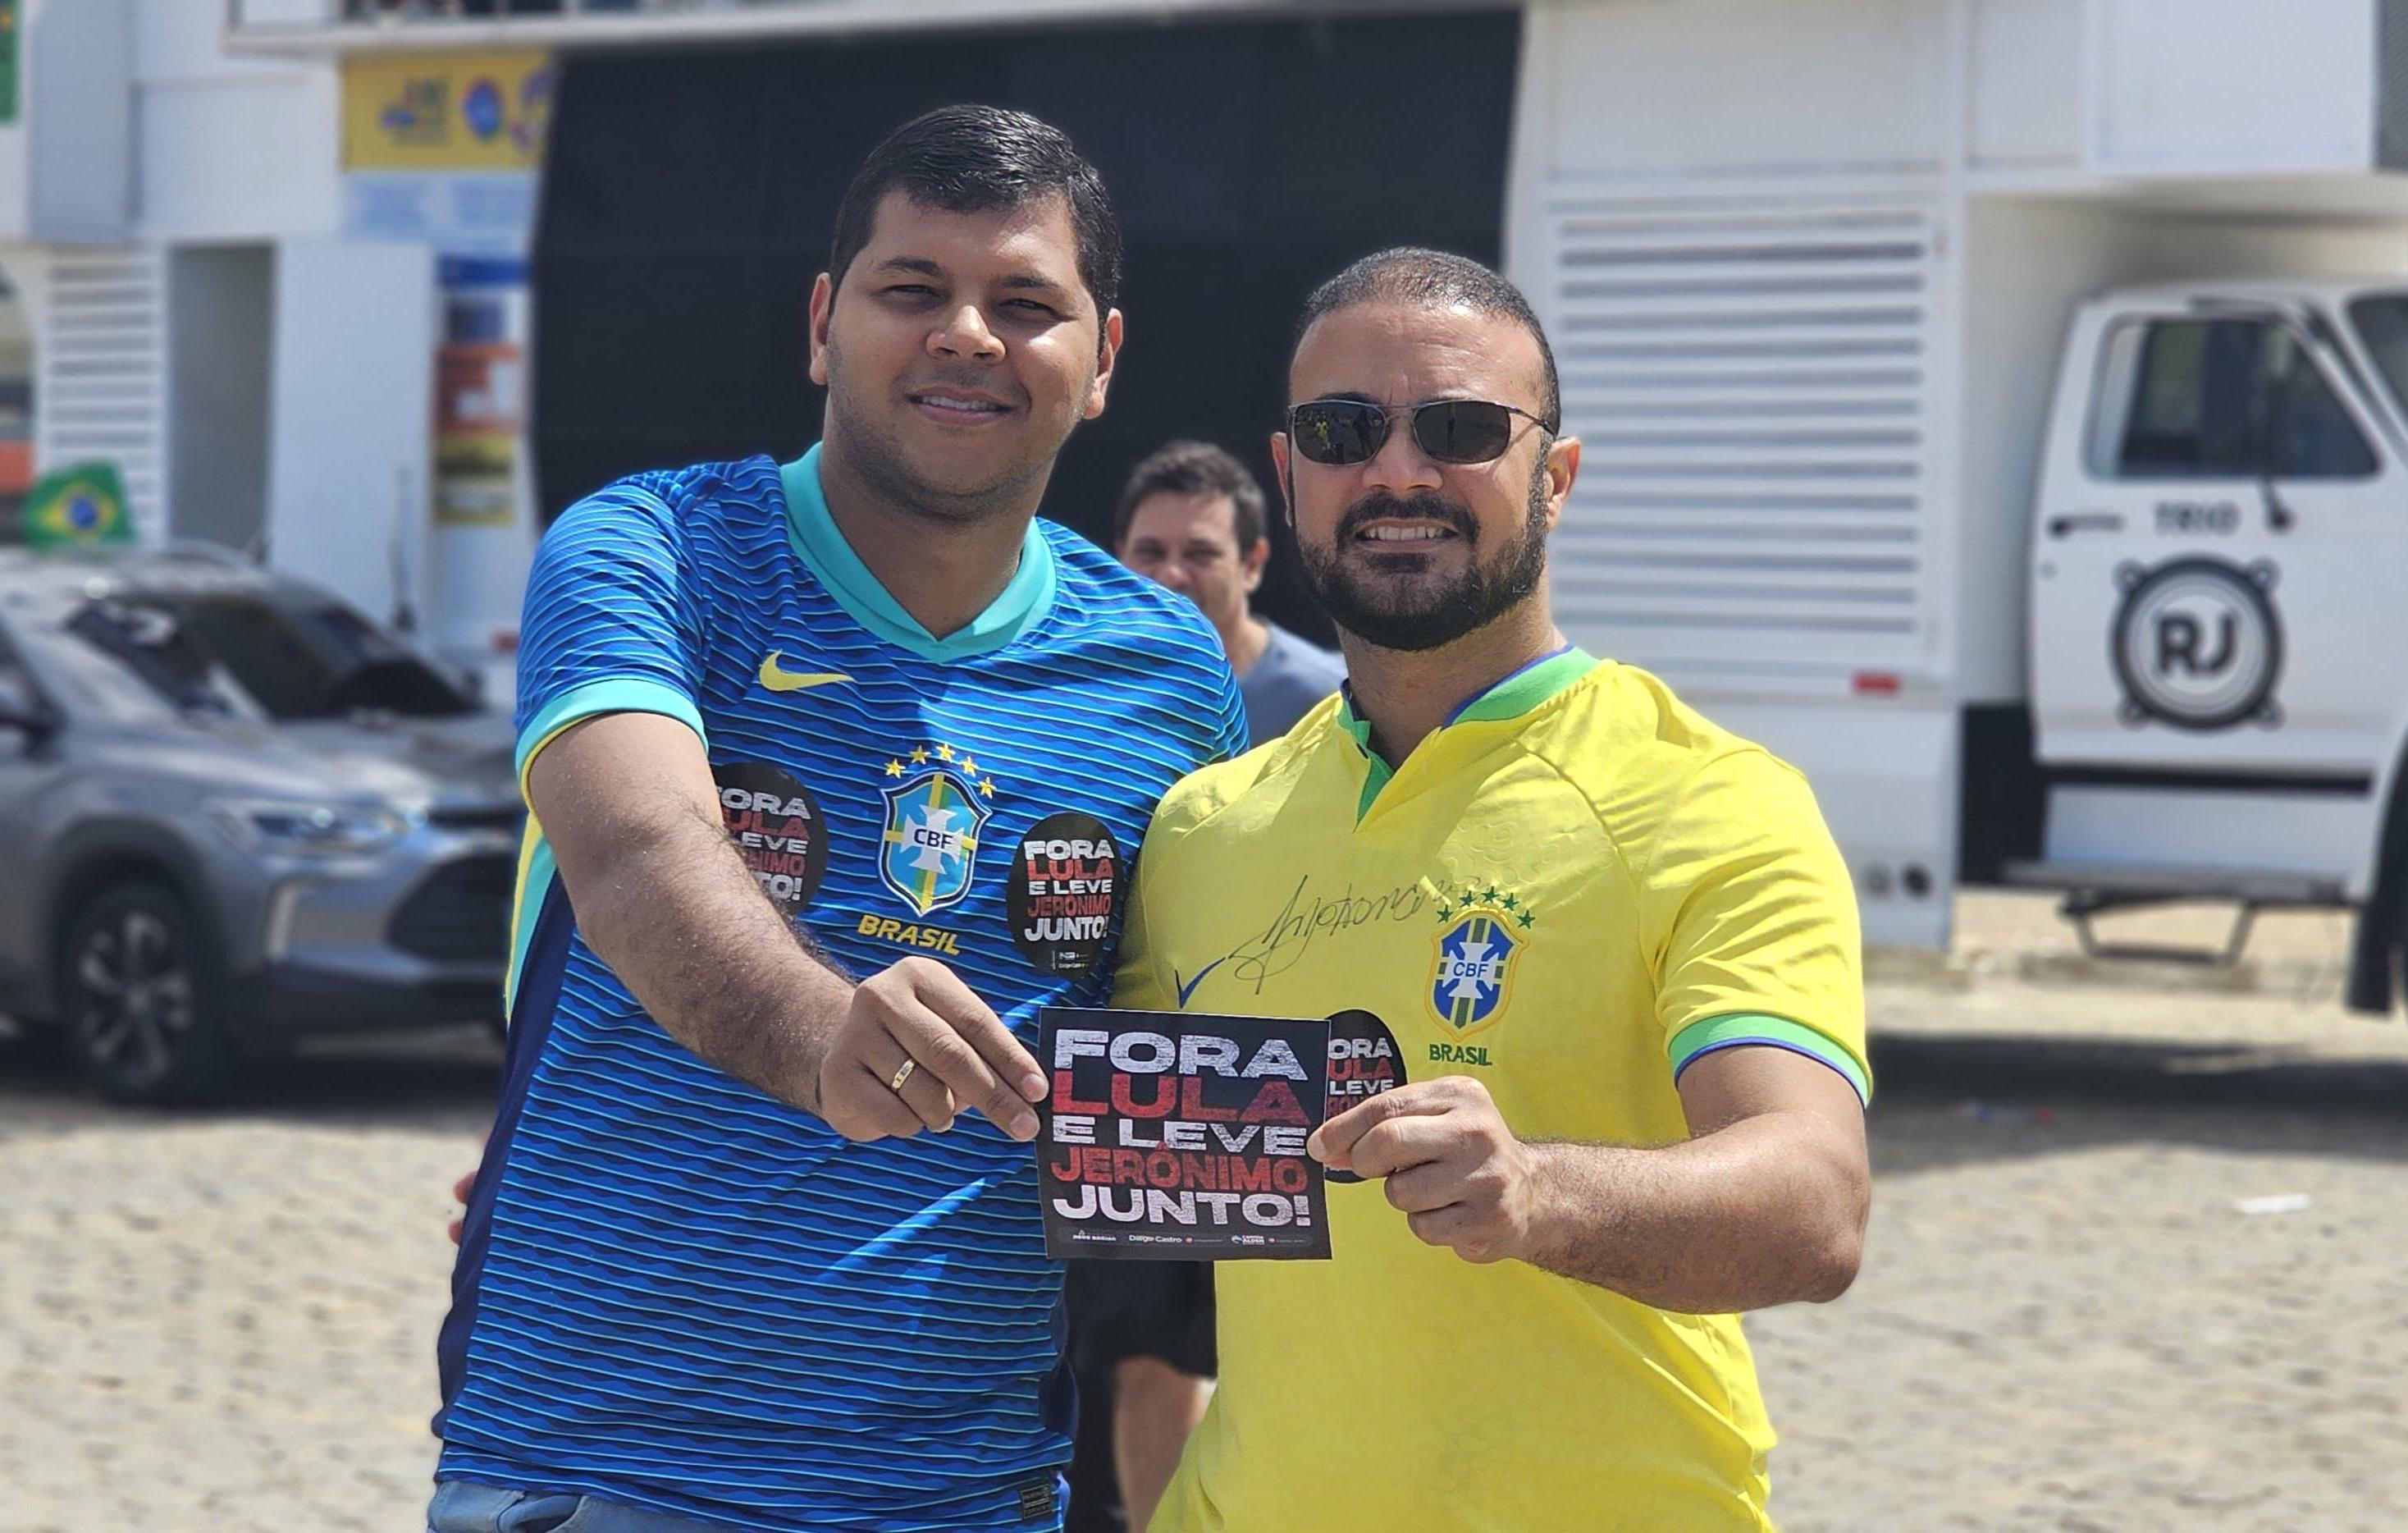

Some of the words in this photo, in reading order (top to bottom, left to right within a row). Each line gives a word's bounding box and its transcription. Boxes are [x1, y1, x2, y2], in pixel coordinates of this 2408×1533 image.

[2157, 611, 2237, 679] RJ
[717, 786, 811, 820] ORA
[723, 807, 811, 840] ULA
[913, 828, 953, 849] CBF
[1023, 840, 1115, 860] FORA
[1027, 858, 1114, 881] LULA
[1029, 881, 1046, 895] E
[1053, 879, 1113, 895] LEVE
[857, 914, 960, 956] BRASIL
[1024, 916, 1109, 942] JUNTO!
[1453, 962, 1488, 977] CBF
[1053, 1028, 1309, 1081] FORA
[1327, 1037, 1393, 1060] ORA
[1429, 1043, 1493, 1066] BRASIL
[1327, 1057, 1395, 1082] ULA
[1051, 1070, 1309, 1123] LULA
[1053, 1115, 1095, 1144] E
[1119, 1119, 1307, 1156] LEVE
[1050, 1141, 1308, 1193] JERÔNIMO
[1053, 1185, 1311, 1227] JUNTO!
